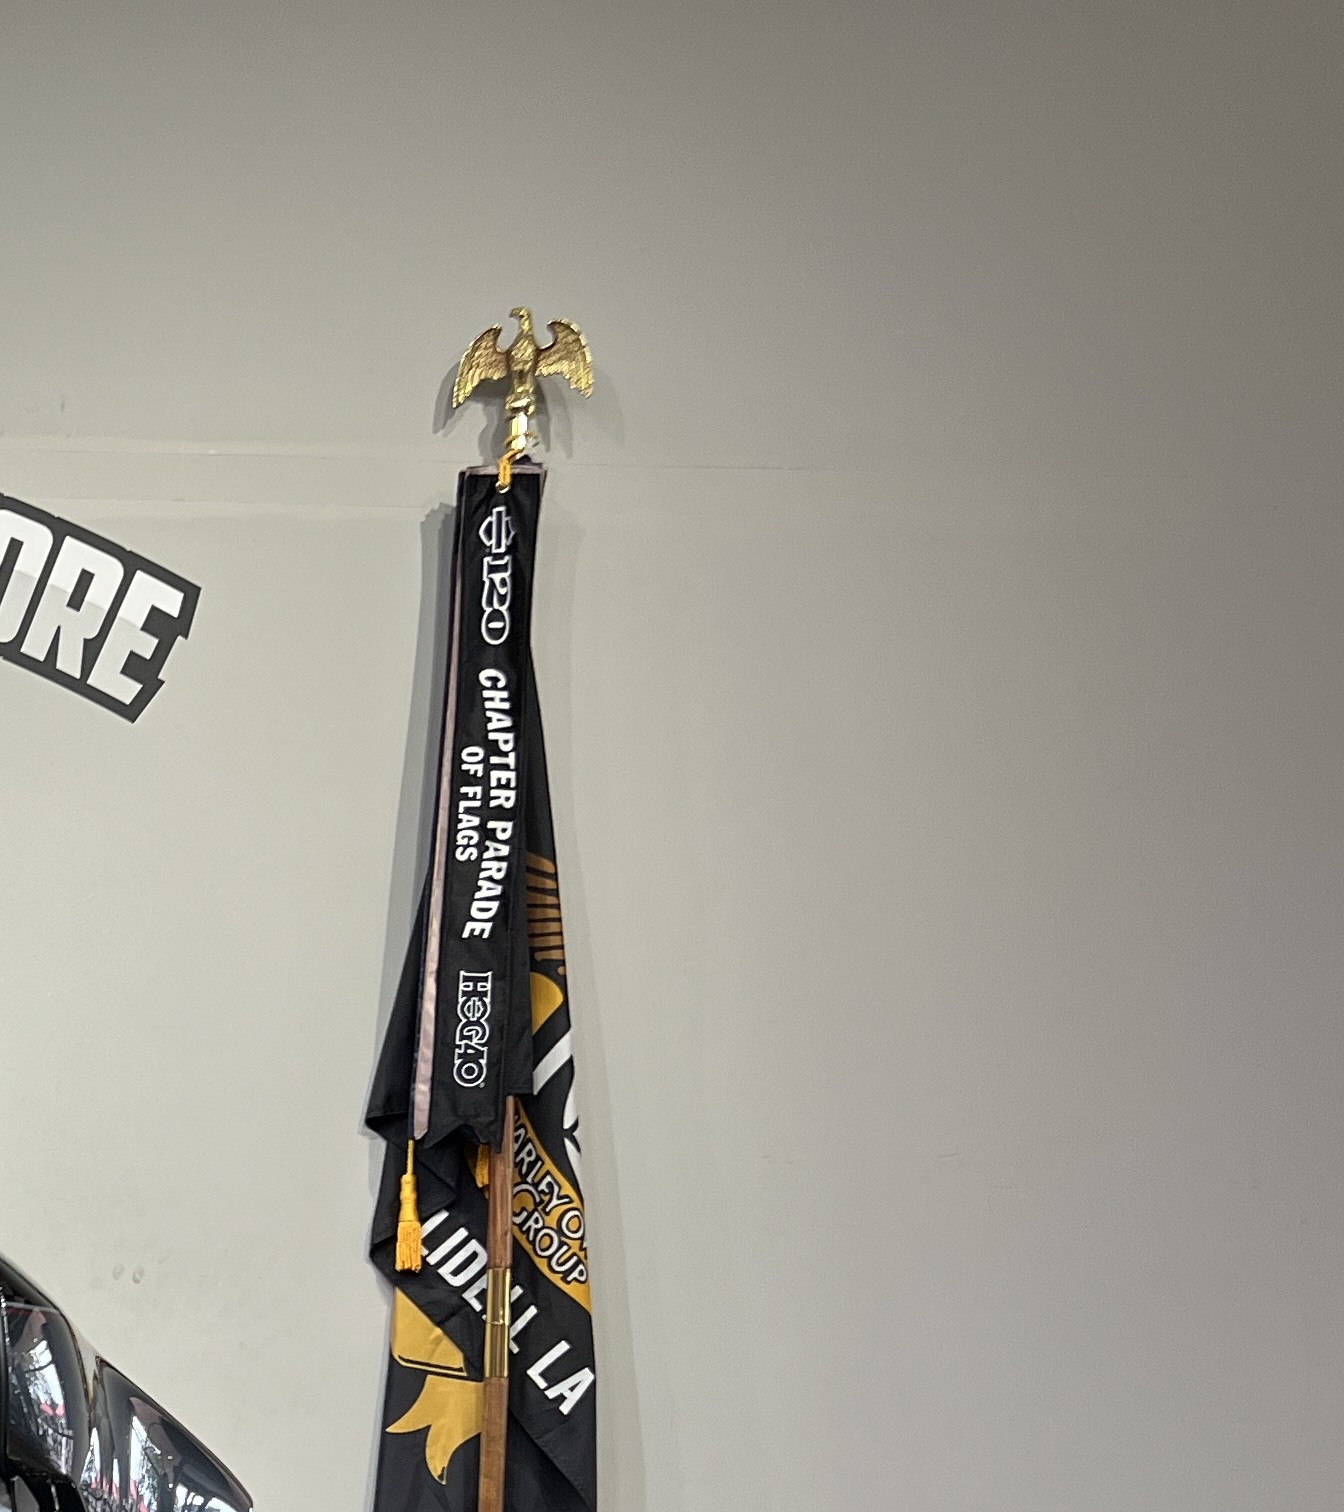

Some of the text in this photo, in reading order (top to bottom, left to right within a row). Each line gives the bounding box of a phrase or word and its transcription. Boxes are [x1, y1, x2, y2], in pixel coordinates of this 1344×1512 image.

[455, 745, 484, 862] OF FLAGS
[462, 668, 517, 939] CHAPTER PARADE
[513, 1183, 588, 1283] GROUP
[526, 1339, 595, 1415] LA
